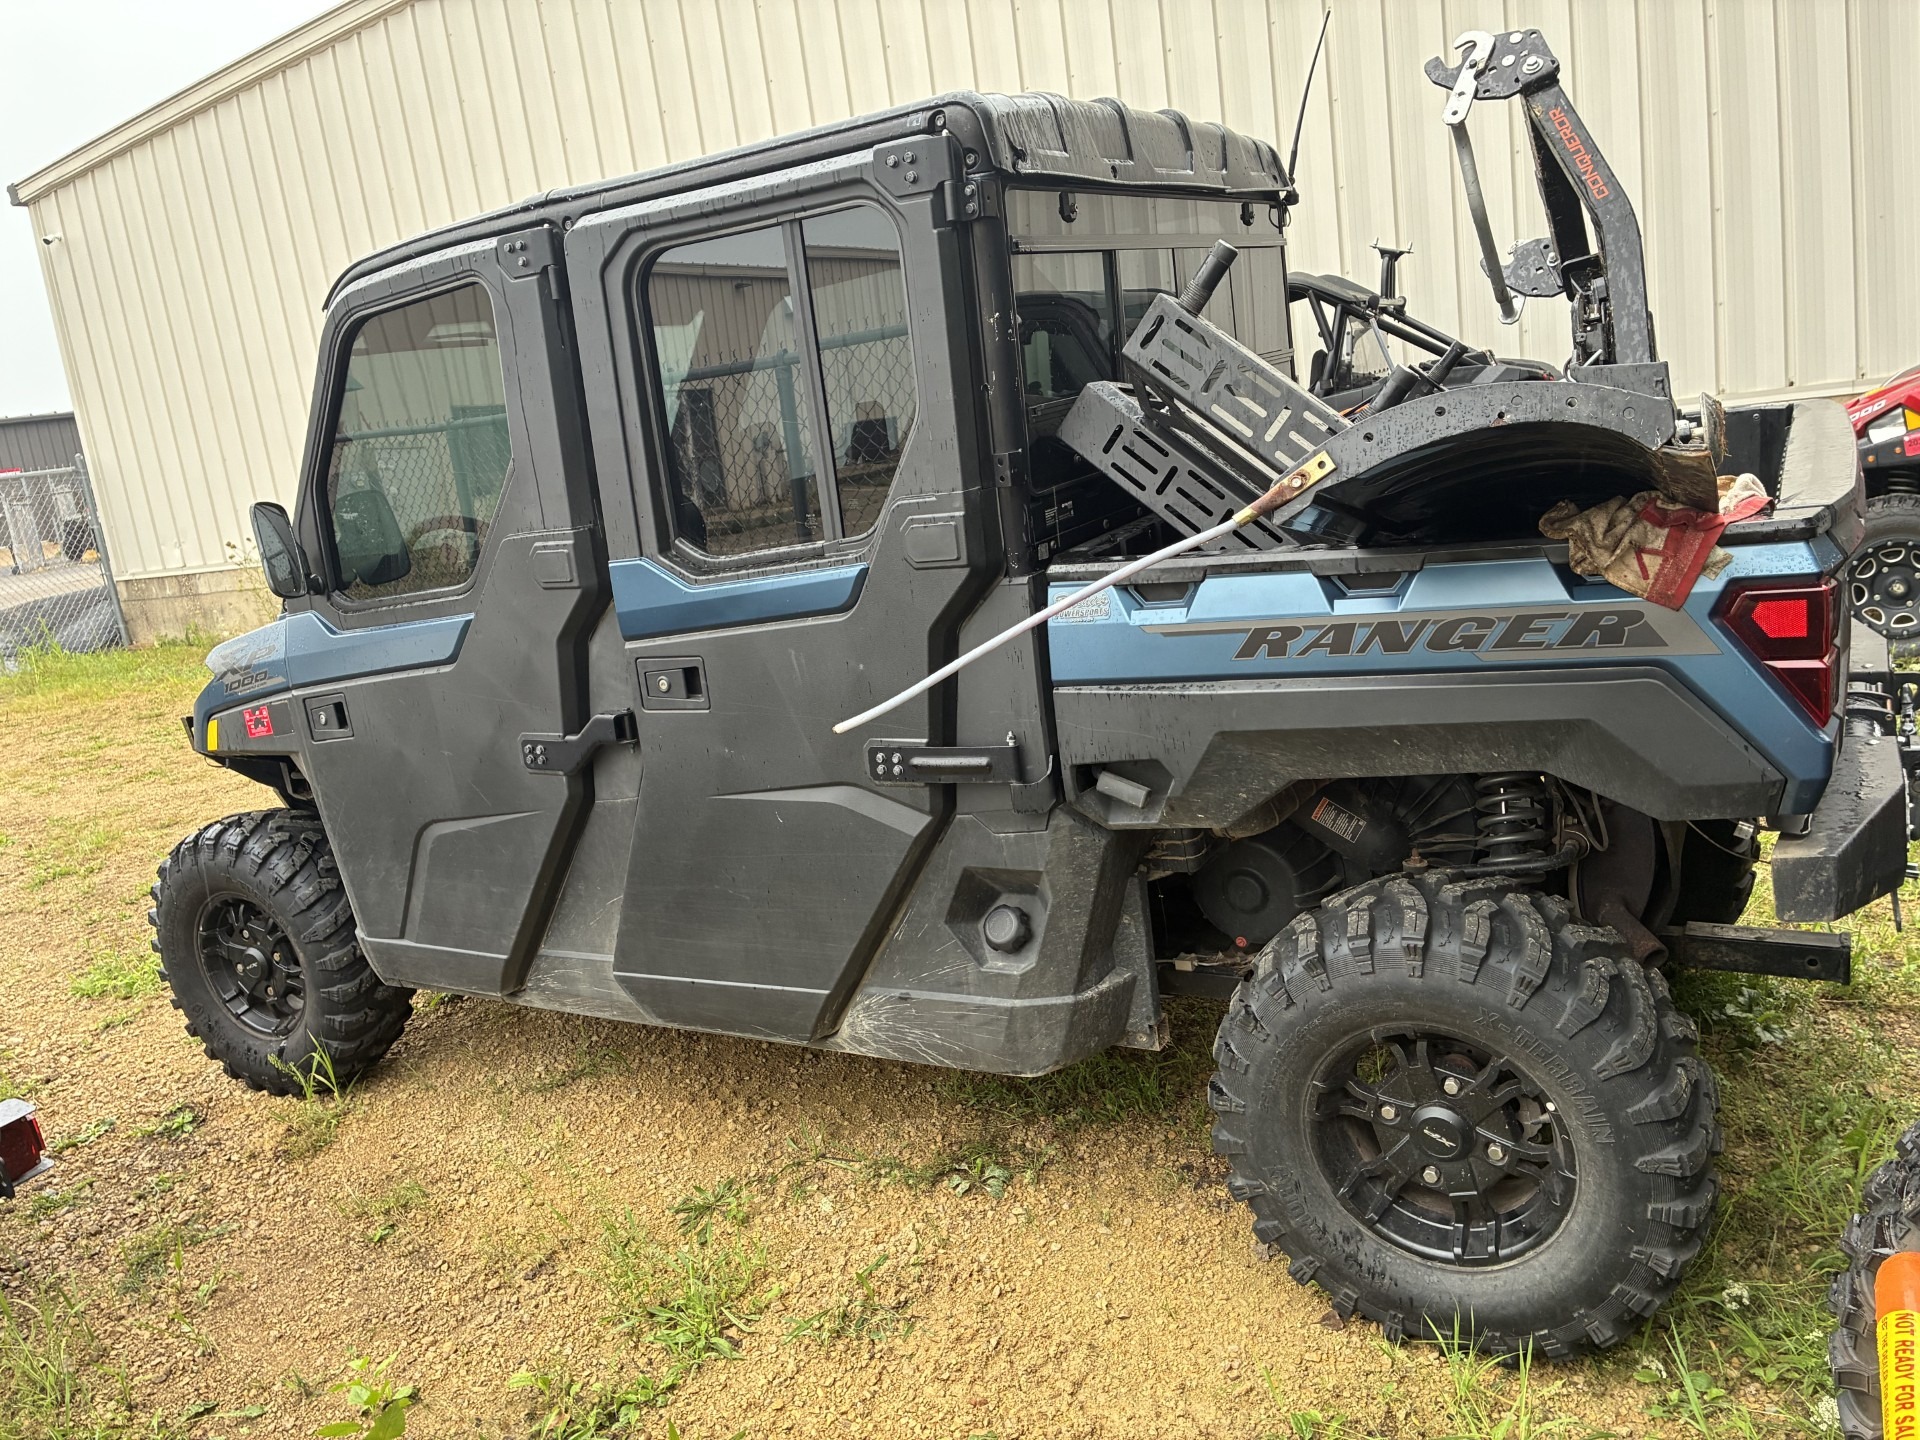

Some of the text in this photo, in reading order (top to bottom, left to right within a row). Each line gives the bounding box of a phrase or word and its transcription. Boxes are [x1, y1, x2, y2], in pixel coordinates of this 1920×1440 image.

[1548, 106, 1610, 200] CONQUEROR
[1231, 608, 1667, 661] RANGER
[224, 670, 267, 694] 1000
[1895, 1312, 1915, 1335] NOT
[1895, 1339, 1915, 1381] READY
[1894, 1384, 1915, 1413] FOR
